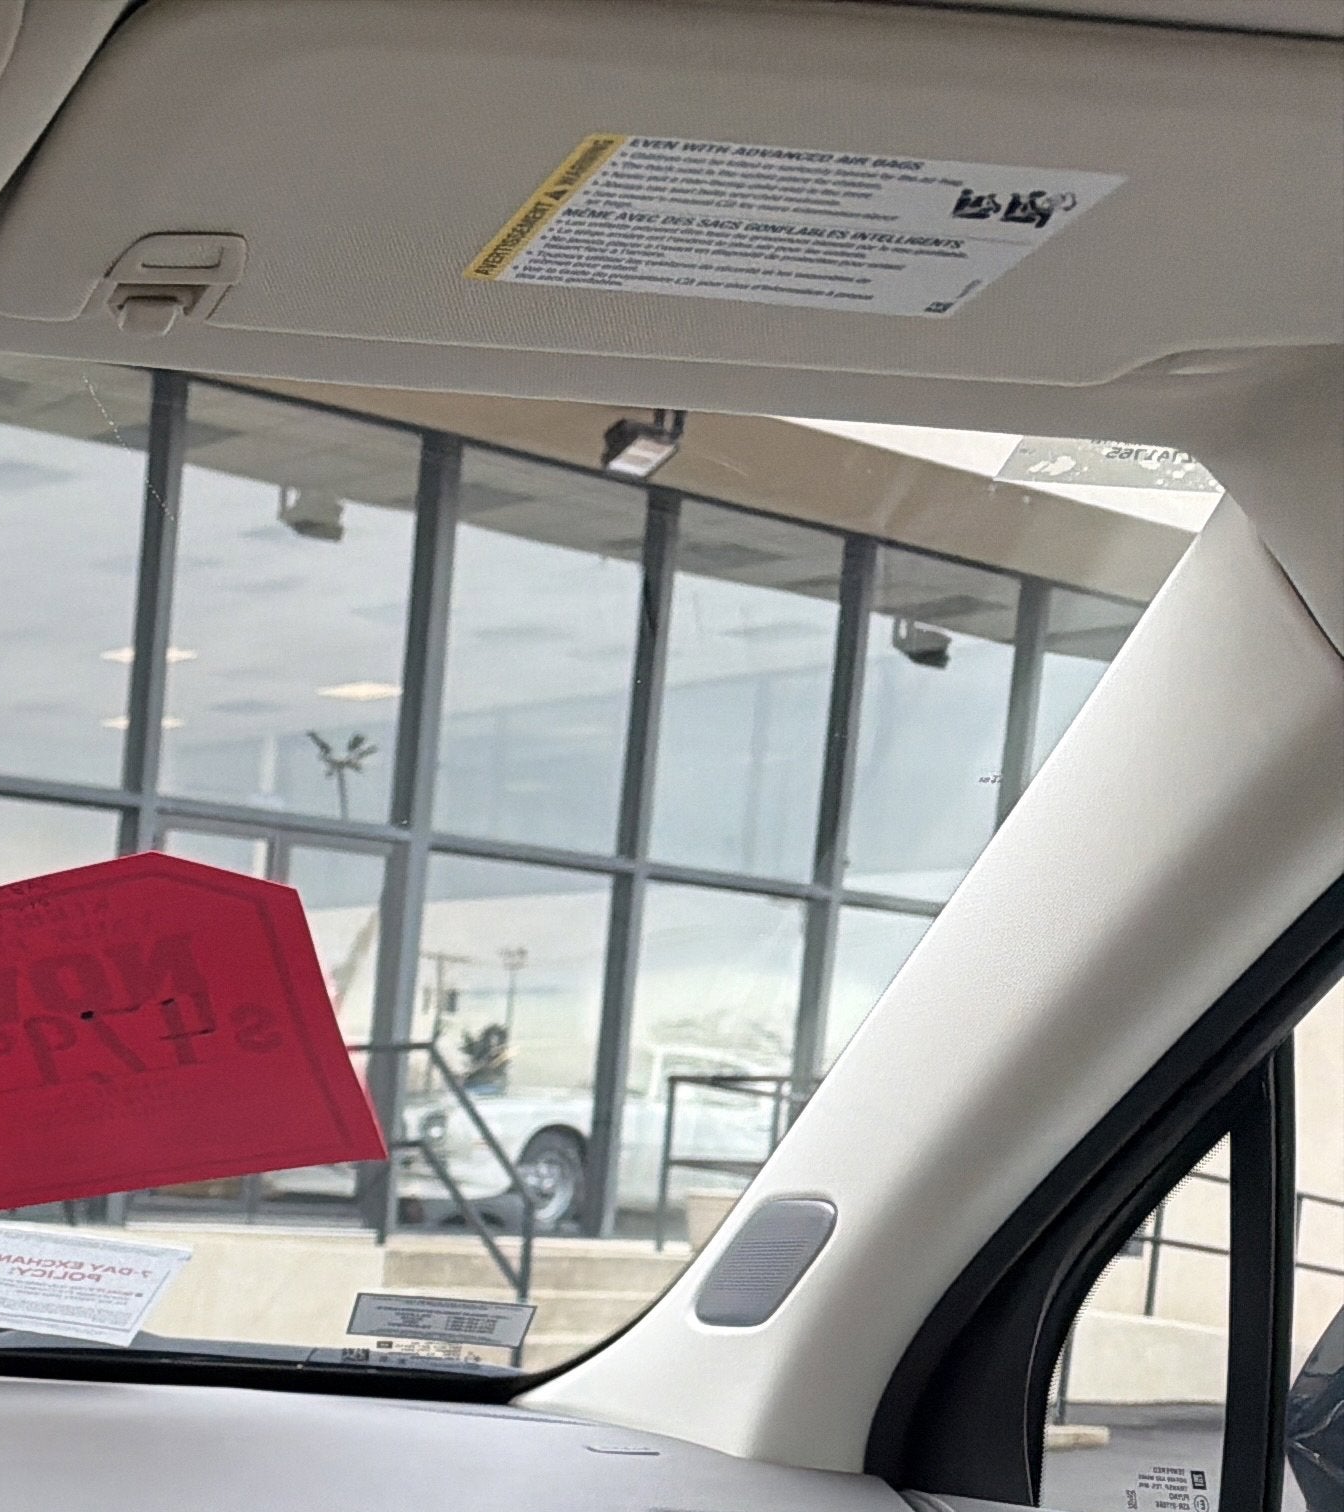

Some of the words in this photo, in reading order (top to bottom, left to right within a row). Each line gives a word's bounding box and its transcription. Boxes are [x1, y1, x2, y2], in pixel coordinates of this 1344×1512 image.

[630, 138, 680, 151] EVEN
[683, 141, 731, 155] WITH
[732, 147, 834, 163] ADVANCED
[617, 212, 660, 224] AVEC
[662, 215, 697, 226] DES
[698, 218, 743, 230] SACS
[744, 220, 848, 240] GONFLABLES
[850, 231, 964, 248] INTELLIGENTS
